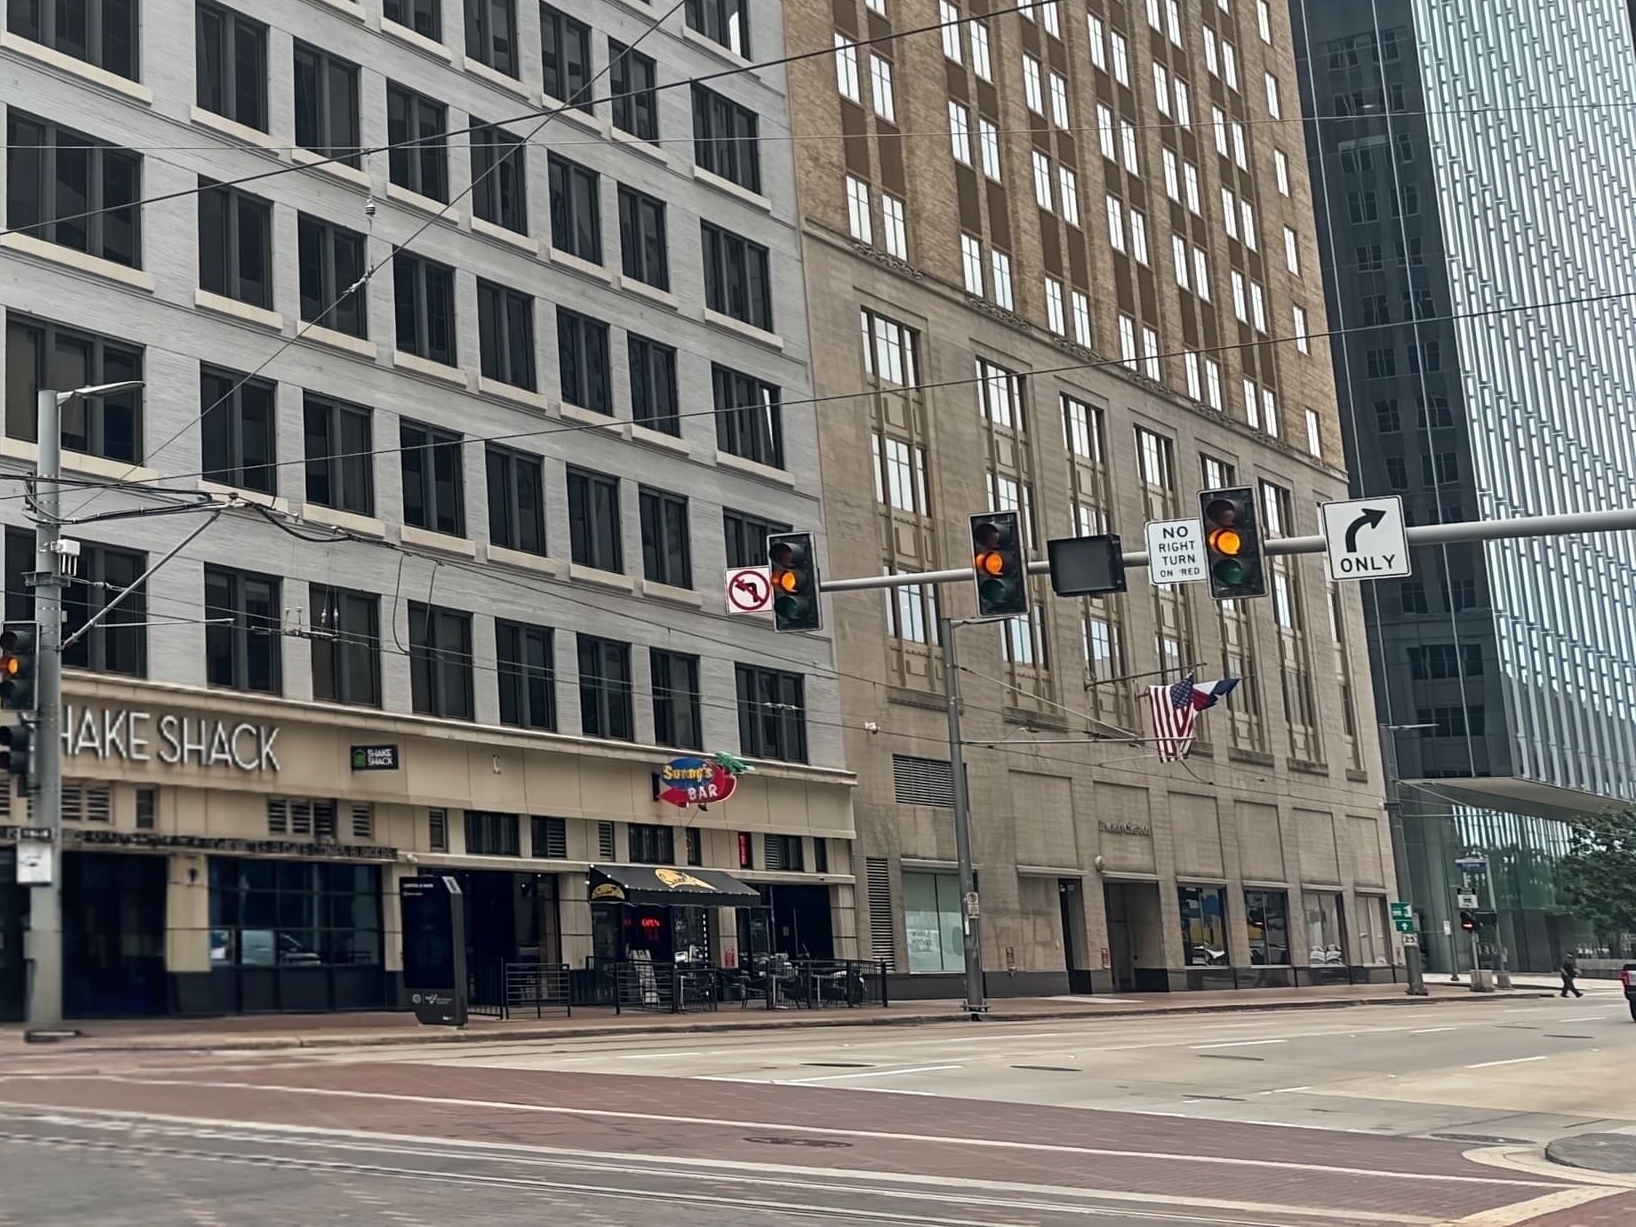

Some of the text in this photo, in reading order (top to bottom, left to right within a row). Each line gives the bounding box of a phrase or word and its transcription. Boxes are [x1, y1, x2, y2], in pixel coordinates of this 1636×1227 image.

[1162, 526, 1188, 539] NO
[1158, 540, 1195, 553] RIGHT
[1162, 554, 1196, 566] TURN
[1340, 554, 1395, 573] ONLY
[1160, 567, 1200, 578] ON RED
[61, 705, 280, 771] HAKE SHACK
[687, 784, 718, 800] BAR
